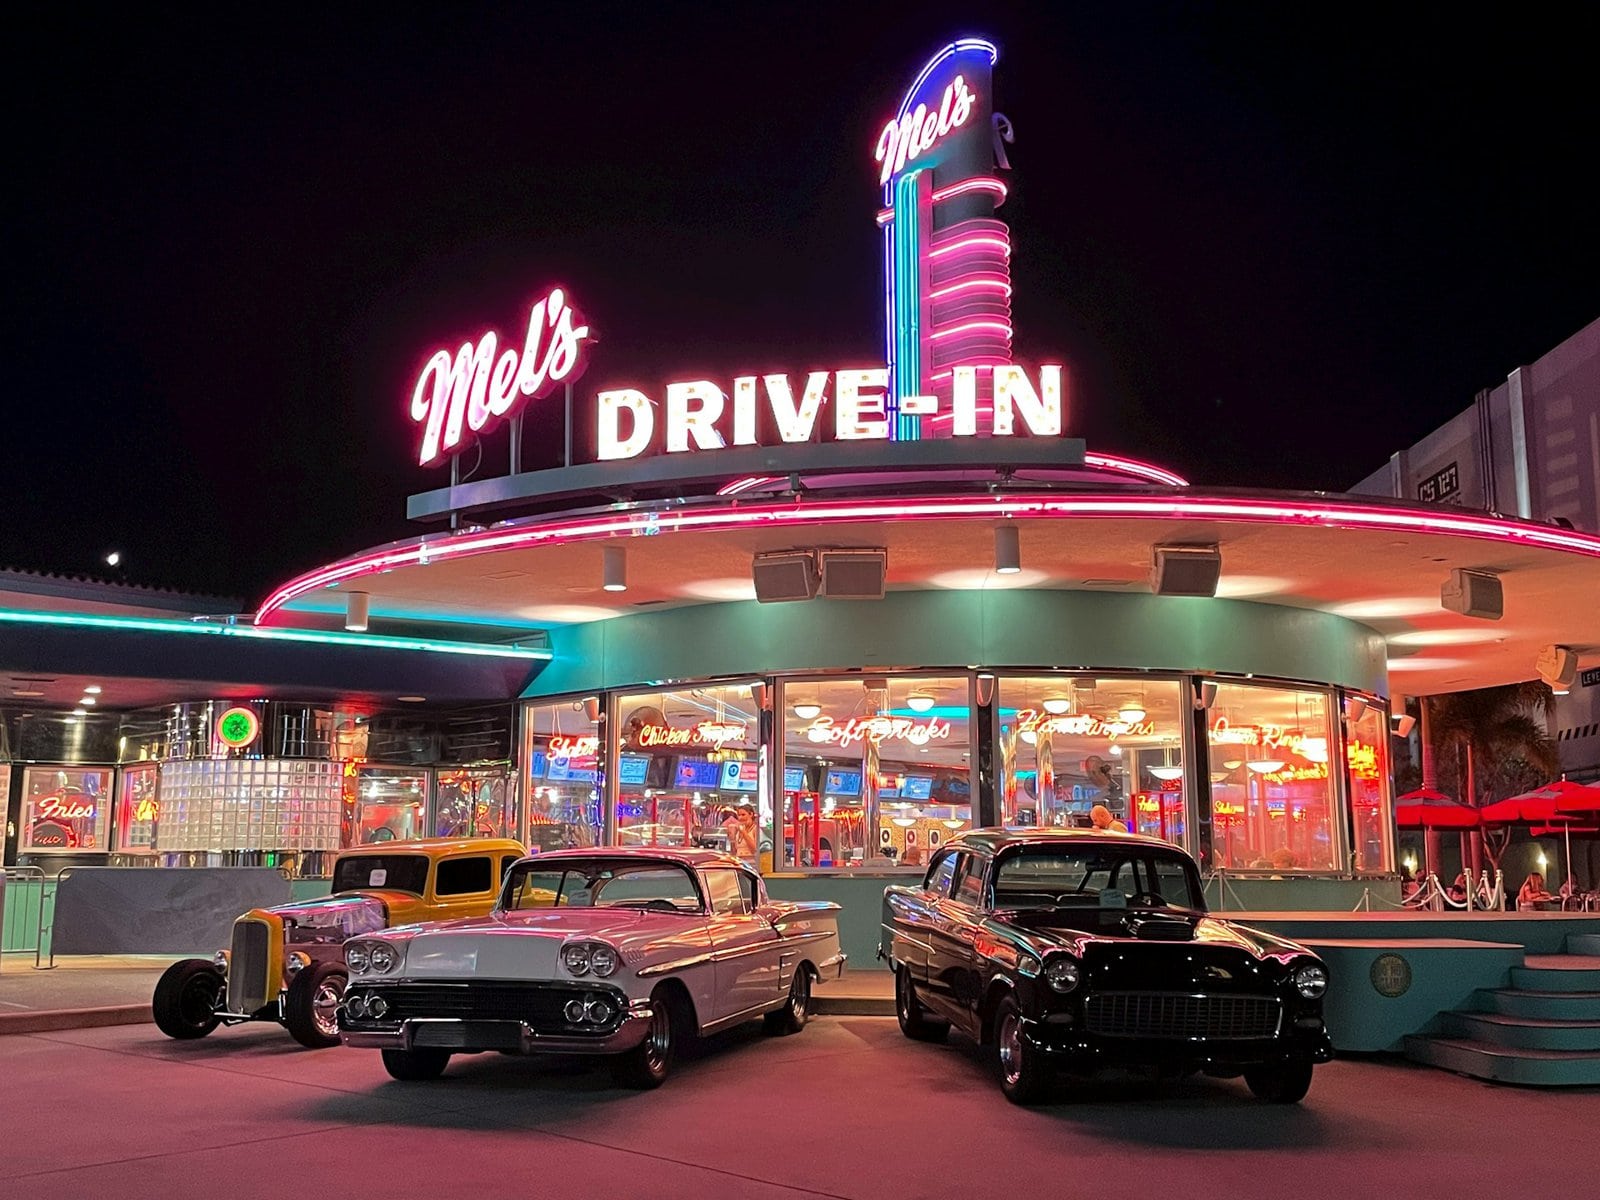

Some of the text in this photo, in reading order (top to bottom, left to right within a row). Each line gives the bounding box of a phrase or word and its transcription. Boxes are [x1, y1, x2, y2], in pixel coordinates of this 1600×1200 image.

[876, 74, 975, 183] Mel's
[410, 287, 590, 466] Mel's
[596, 364, 1064, 462] DRIVE-IN
[638, 724, 690, 746] Chicken
[808, 716, 951, 747] Soft Drinks
[1017, 709, 1155, 741] Hamburgers
[39, 797, 93, 818] Fries
